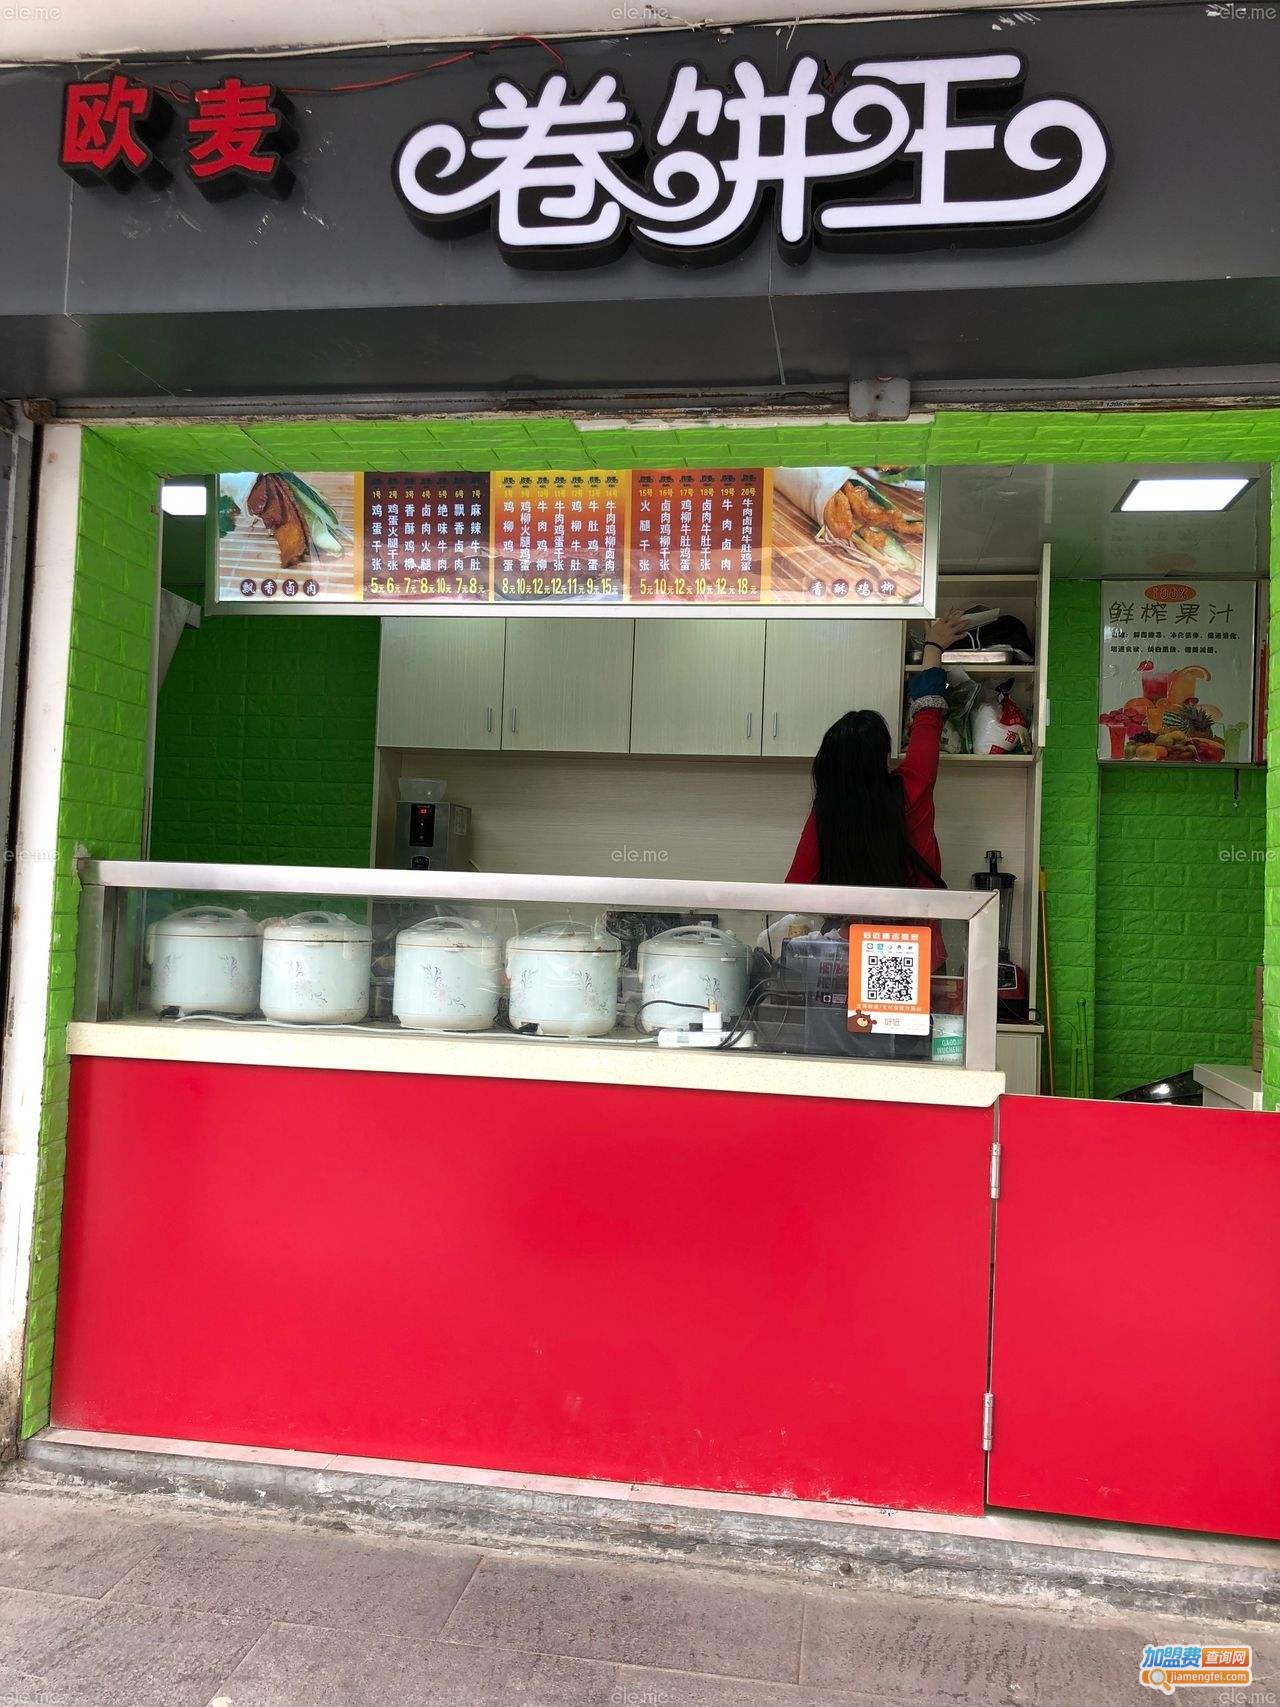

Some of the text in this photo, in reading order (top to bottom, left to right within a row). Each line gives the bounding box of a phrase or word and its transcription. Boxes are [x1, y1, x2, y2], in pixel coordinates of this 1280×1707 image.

[60, 75, 277, 178] 欧麦
[398, 54, 1107, 246] 卷饼王
[241, 581, 318, 596] 飘香卤肉
[370, 578, 384, 594] 5元
[387, 578, 400, 594] 6元
[404, 578, 416, 594] 7元
[420, 578, 435, 594] 8元
[437, 578, 452, 594] 10元
[456, 578, 468, 594] 7元
[469, 578, 485, 594] 8元
[502, 578, 515, 594] 8元
[516, 578, 532, 594] 10元
[533, 578, 550, 594] 12元
[551, 578, 567, 594] 12元
[568, 578, 585, 594] 11元
[586, 578, 600, 594] 9元
[601, 578, 618, 594] 15元
[640, 578, 653, 595] 5元
[654, 578, 673, 595] 10元
[674, 578, 693, 595] 12元
[695, 578, 714, 595] 10元
[716, 578, 735, 595] 12元
[737, 578, 757, 595] 18元
[811, 580, 895, 597] 香酥鸡柳
[1109, 601, 1234, 624] 鲜榨果汁
